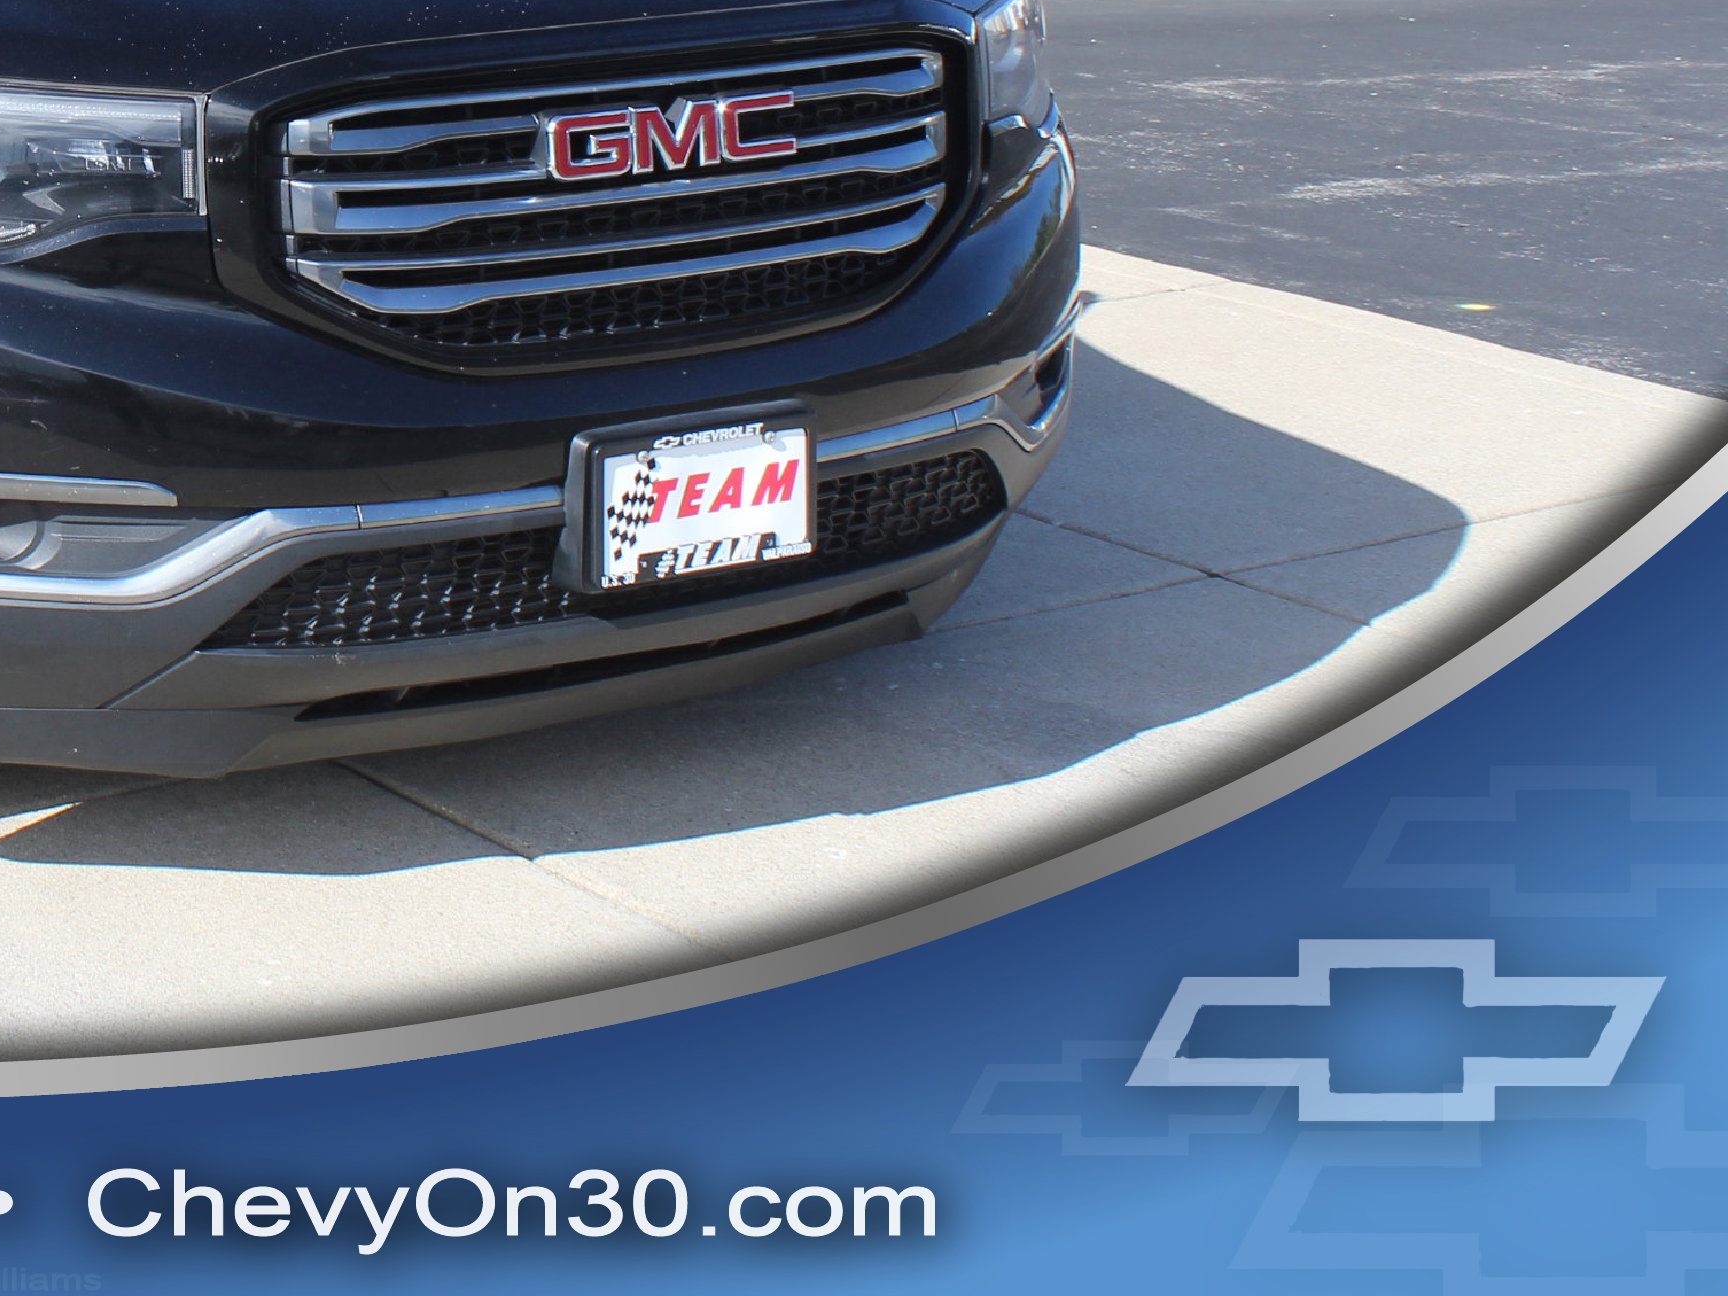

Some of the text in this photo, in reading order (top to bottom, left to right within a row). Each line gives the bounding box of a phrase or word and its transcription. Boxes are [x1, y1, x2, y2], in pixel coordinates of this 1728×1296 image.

[548, 89, 798, 181] GMC
[682, 422, 764, 446] CHEVROLET
[647, 458, 799, 524] TEAM
[675, 533, 762, 573] TEAM
